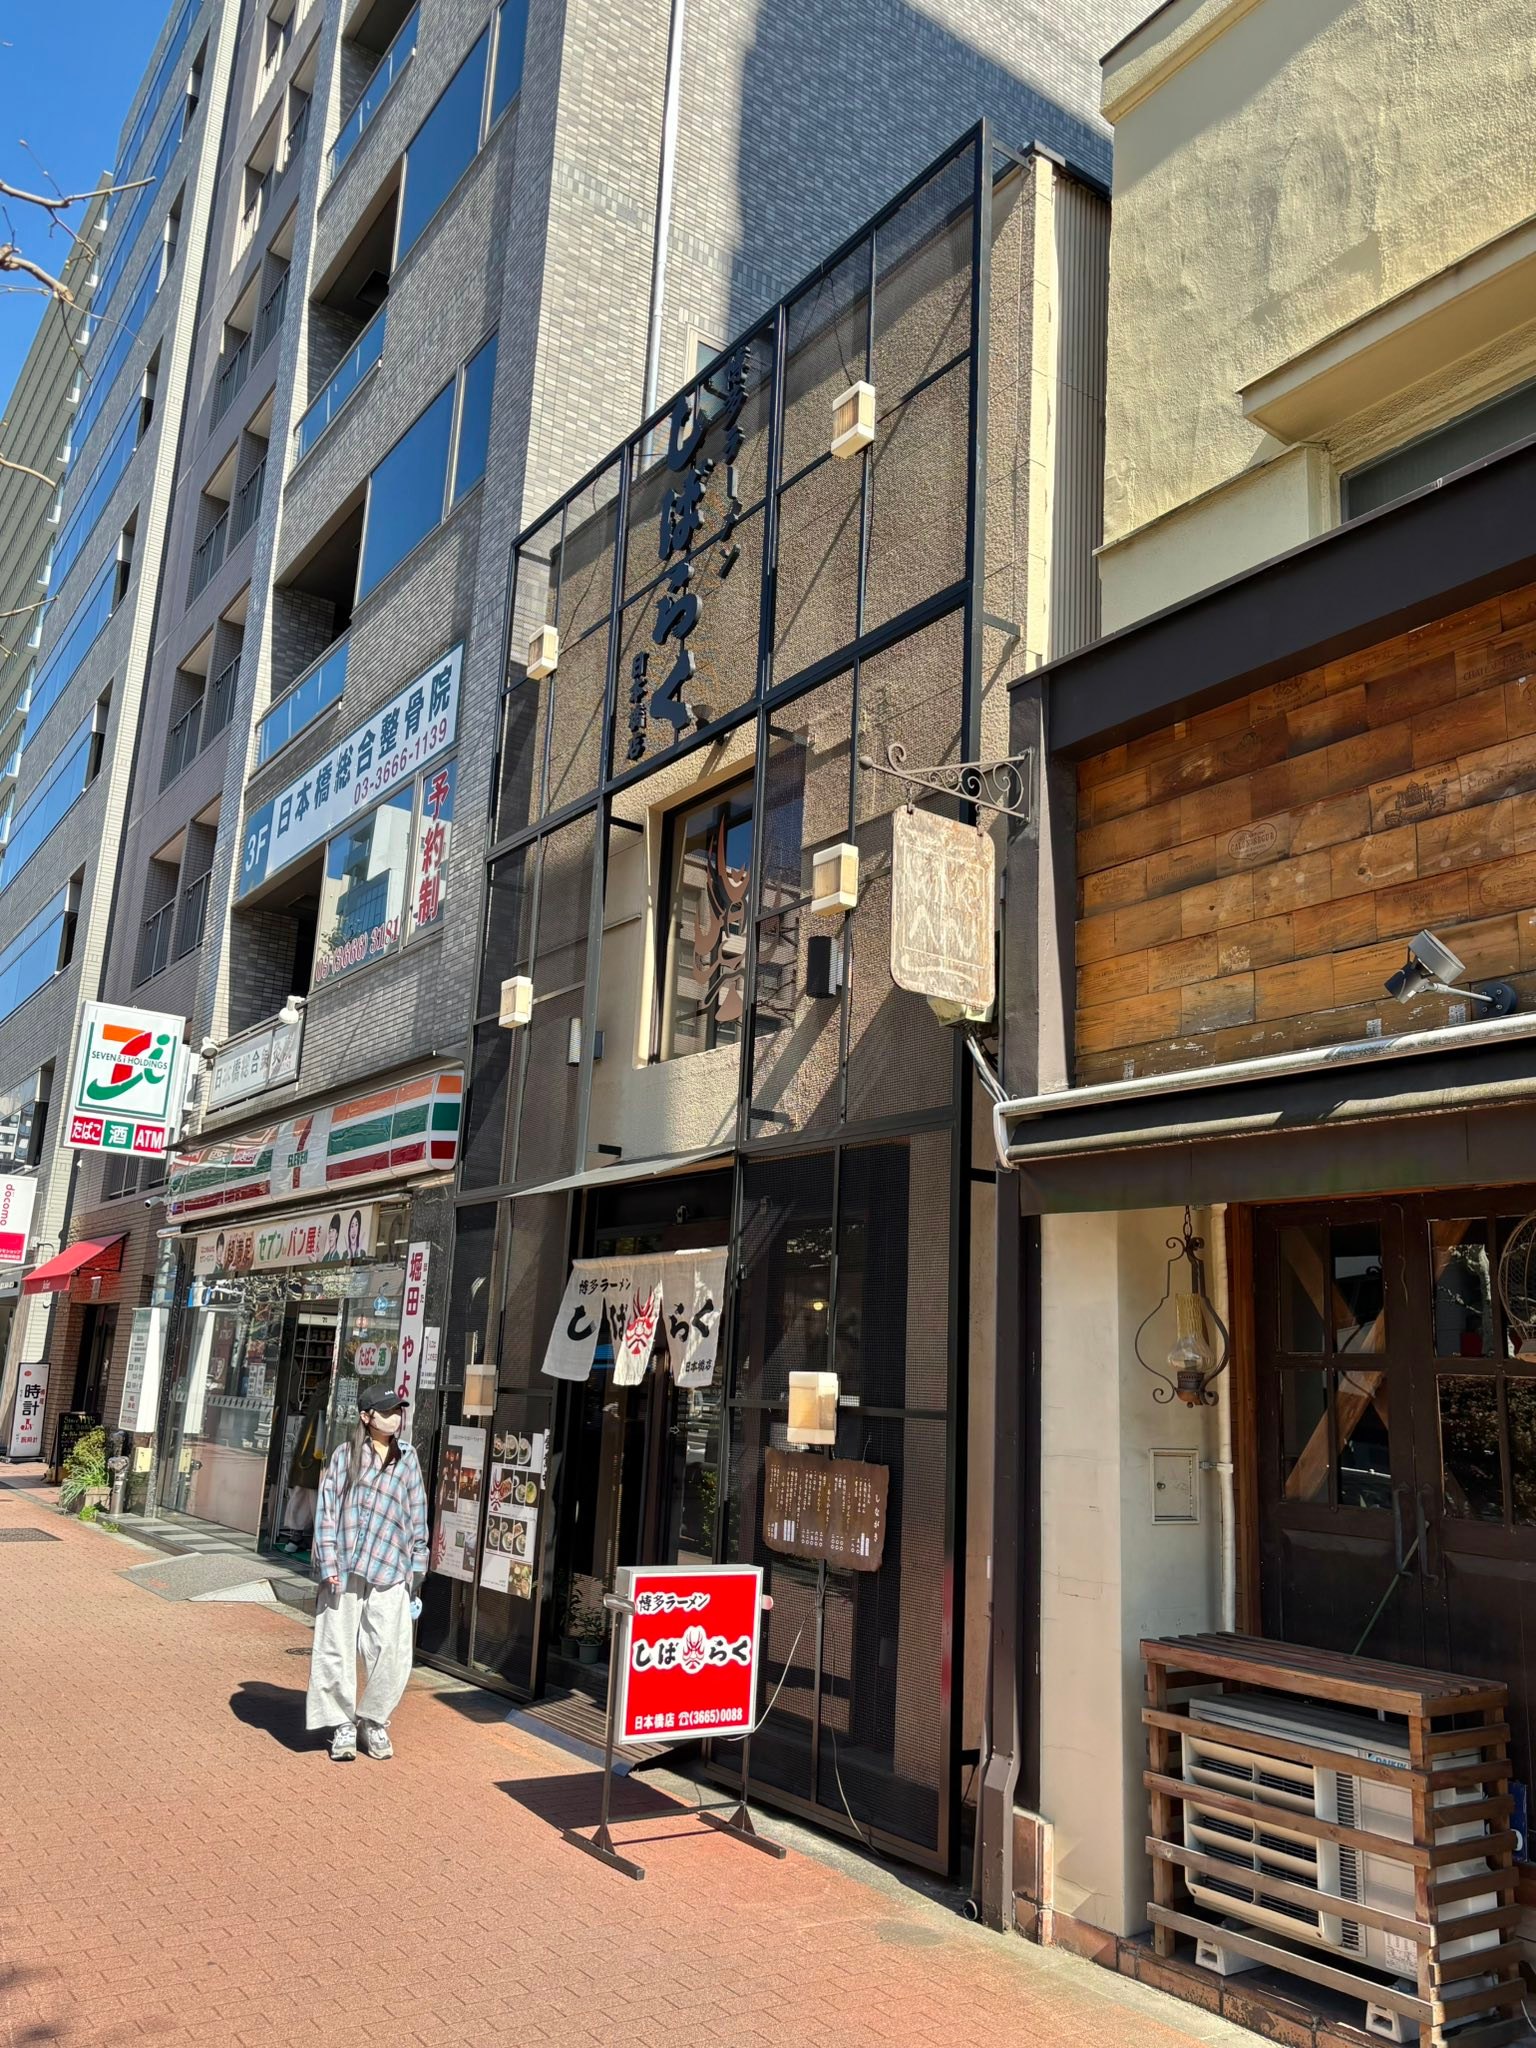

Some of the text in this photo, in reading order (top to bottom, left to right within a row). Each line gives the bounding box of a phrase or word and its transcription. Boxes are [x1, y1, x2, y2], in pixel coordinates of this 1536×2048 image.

[649, 396, 713, 730] しばらく
[275, 664, 453, 839] 日本橋総合整骨院
[354, 717, 448, 806] 03-3666-1139
[245, 822, 269, 872] 3F
[416, 768, 450, 926] 予約制
[128, 1057, 168, 1070] HOLDINGS
[71, 1119, 102, 1141] たばこ
[108, 1124, 129, 1145] 酒
[135, 1129, 164, 1150] ATM
[0, 1183, 15, 1226] docomo
[405, 1251, 424, 1316] 堀田
[578, 1277, 631, 1295] 博多ラーメン
[567, 1298, 714, 1343] しばらく
[358, 1345, 376, 1367] たばこ
[685, 1358, 713, 1373] 日本橋店
[22, 1383, 42, 1416] 時計
[639, 1594, 710, 1612] 博多ラーメン
[635, 1639, 748, 1667] しばらく
[634, 1711, 675, 1730] 日本橋店
